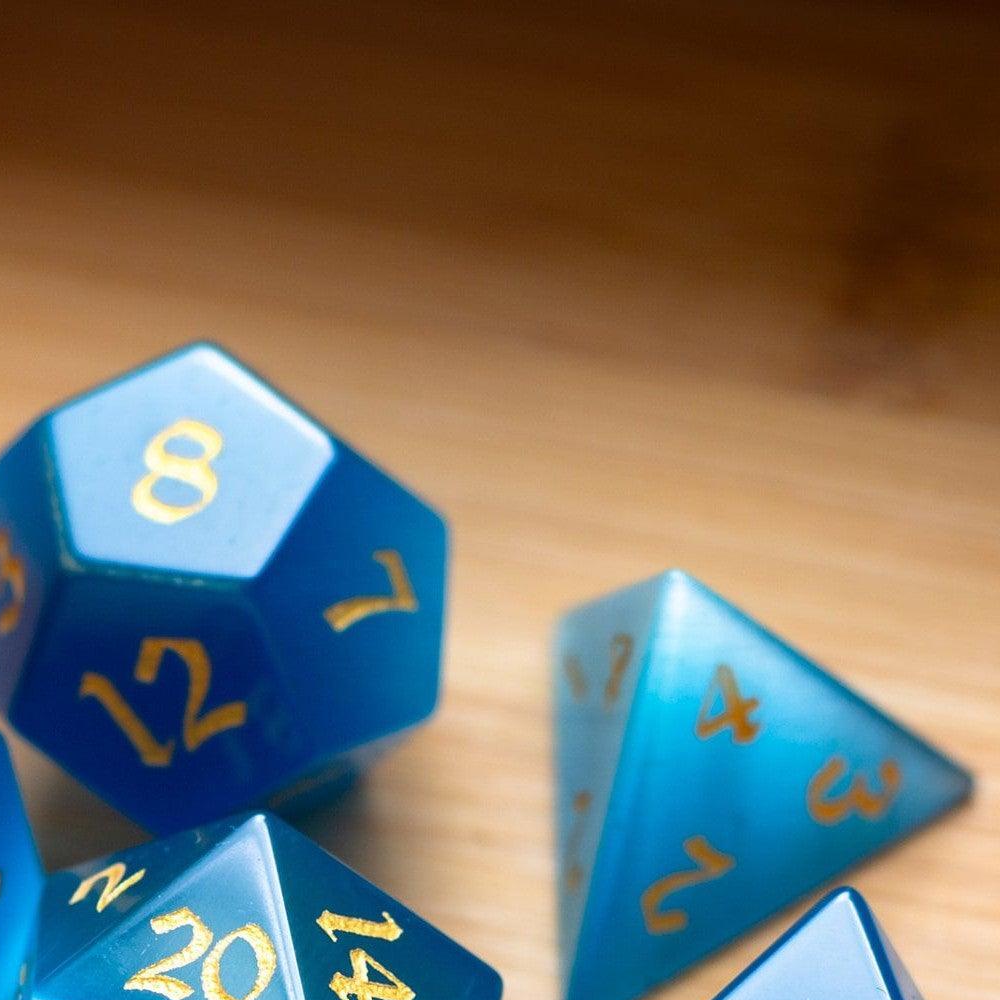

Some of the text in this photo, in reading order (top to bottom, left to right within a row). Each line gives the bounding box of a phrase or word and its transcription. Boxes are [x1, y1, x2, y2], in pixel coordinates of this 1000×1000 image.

[130, 418, 223, 525] 8
[324, 549, 419, 632] 7
[78, 635, 248, 768] 12
[697, 664, 762, 744] 4
[806, 756, 901, 826] 3
[68, 861, 146, 912] 2
